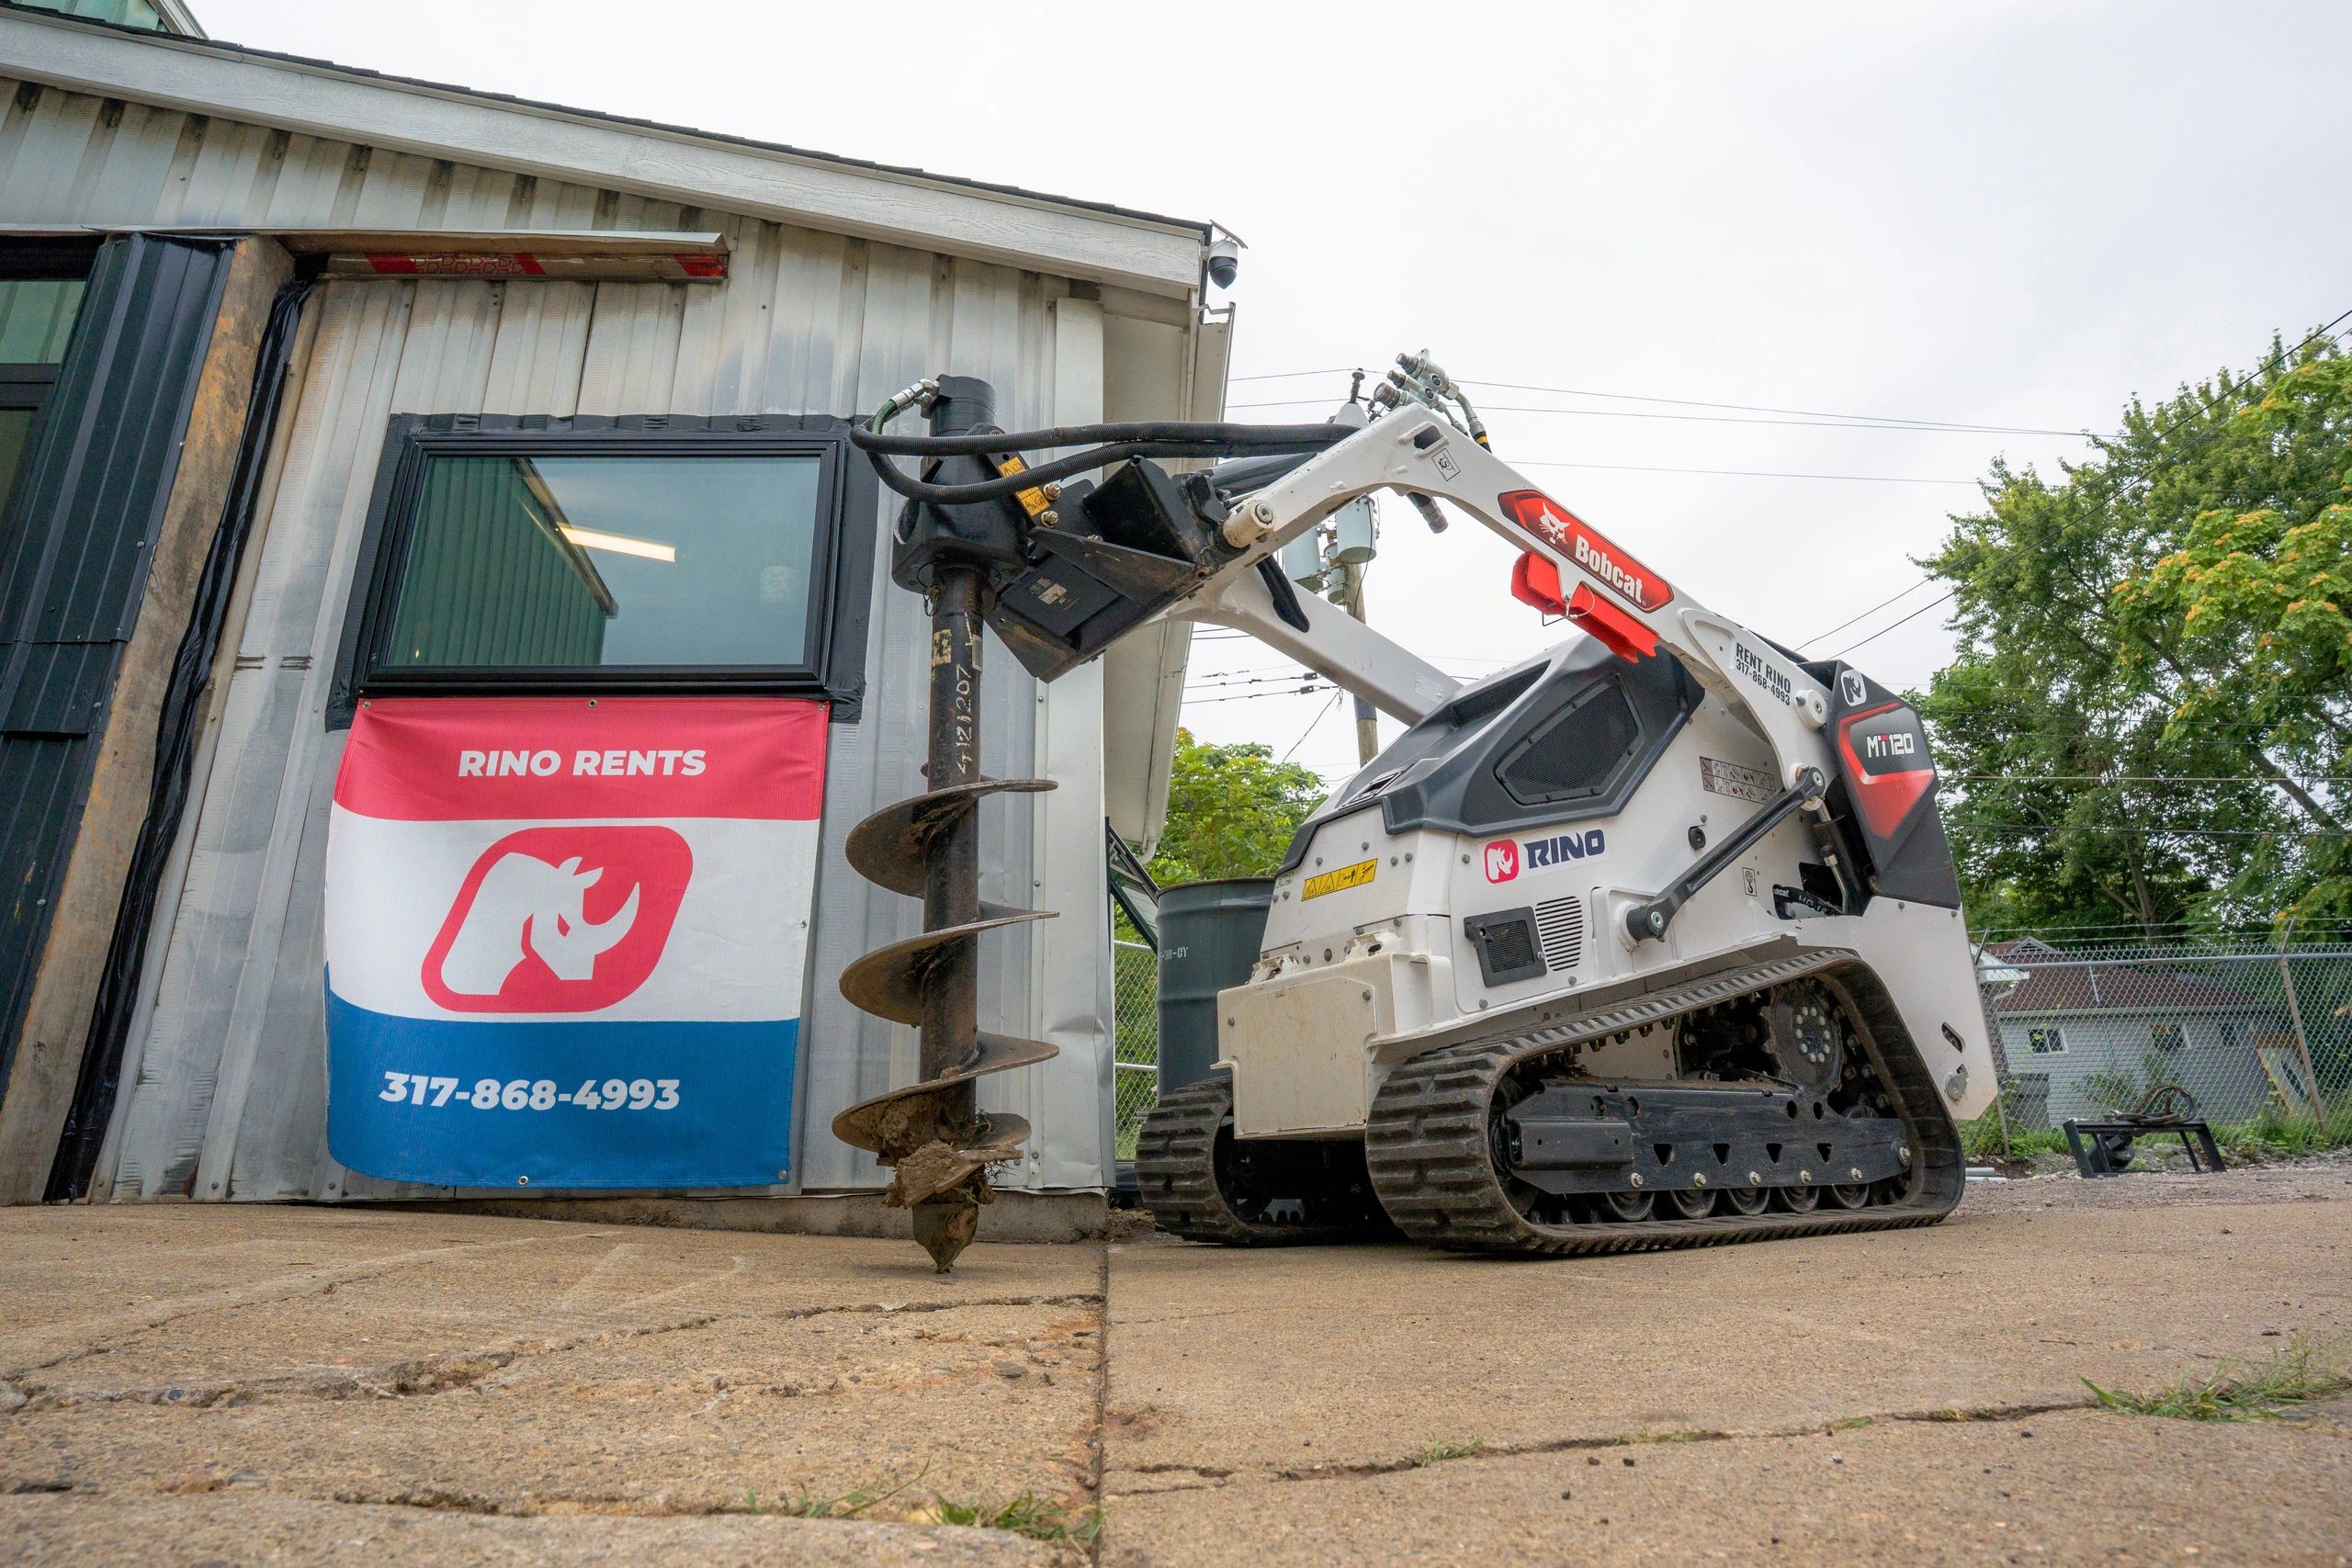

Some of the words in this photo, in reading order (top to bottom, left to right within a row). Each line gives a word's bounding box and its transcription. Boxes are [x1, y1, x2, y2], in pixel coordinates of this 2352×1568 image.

[1575, 534, 1643, 604] Bobcat
[1736, 642, 1762, 672] RENT
[1766, 664, 1791, 694] RINO
[1736, 659, 1791, 705] 317-868-4993
[458, 750, 561, 777] RINO
[572, 750, 707, 776] RENTS
[1866, 733, 1915, 758] MT120
[1523, 829, 1605, 869] RINO
[379, 1071, 680, 1111] 317-868-4993
